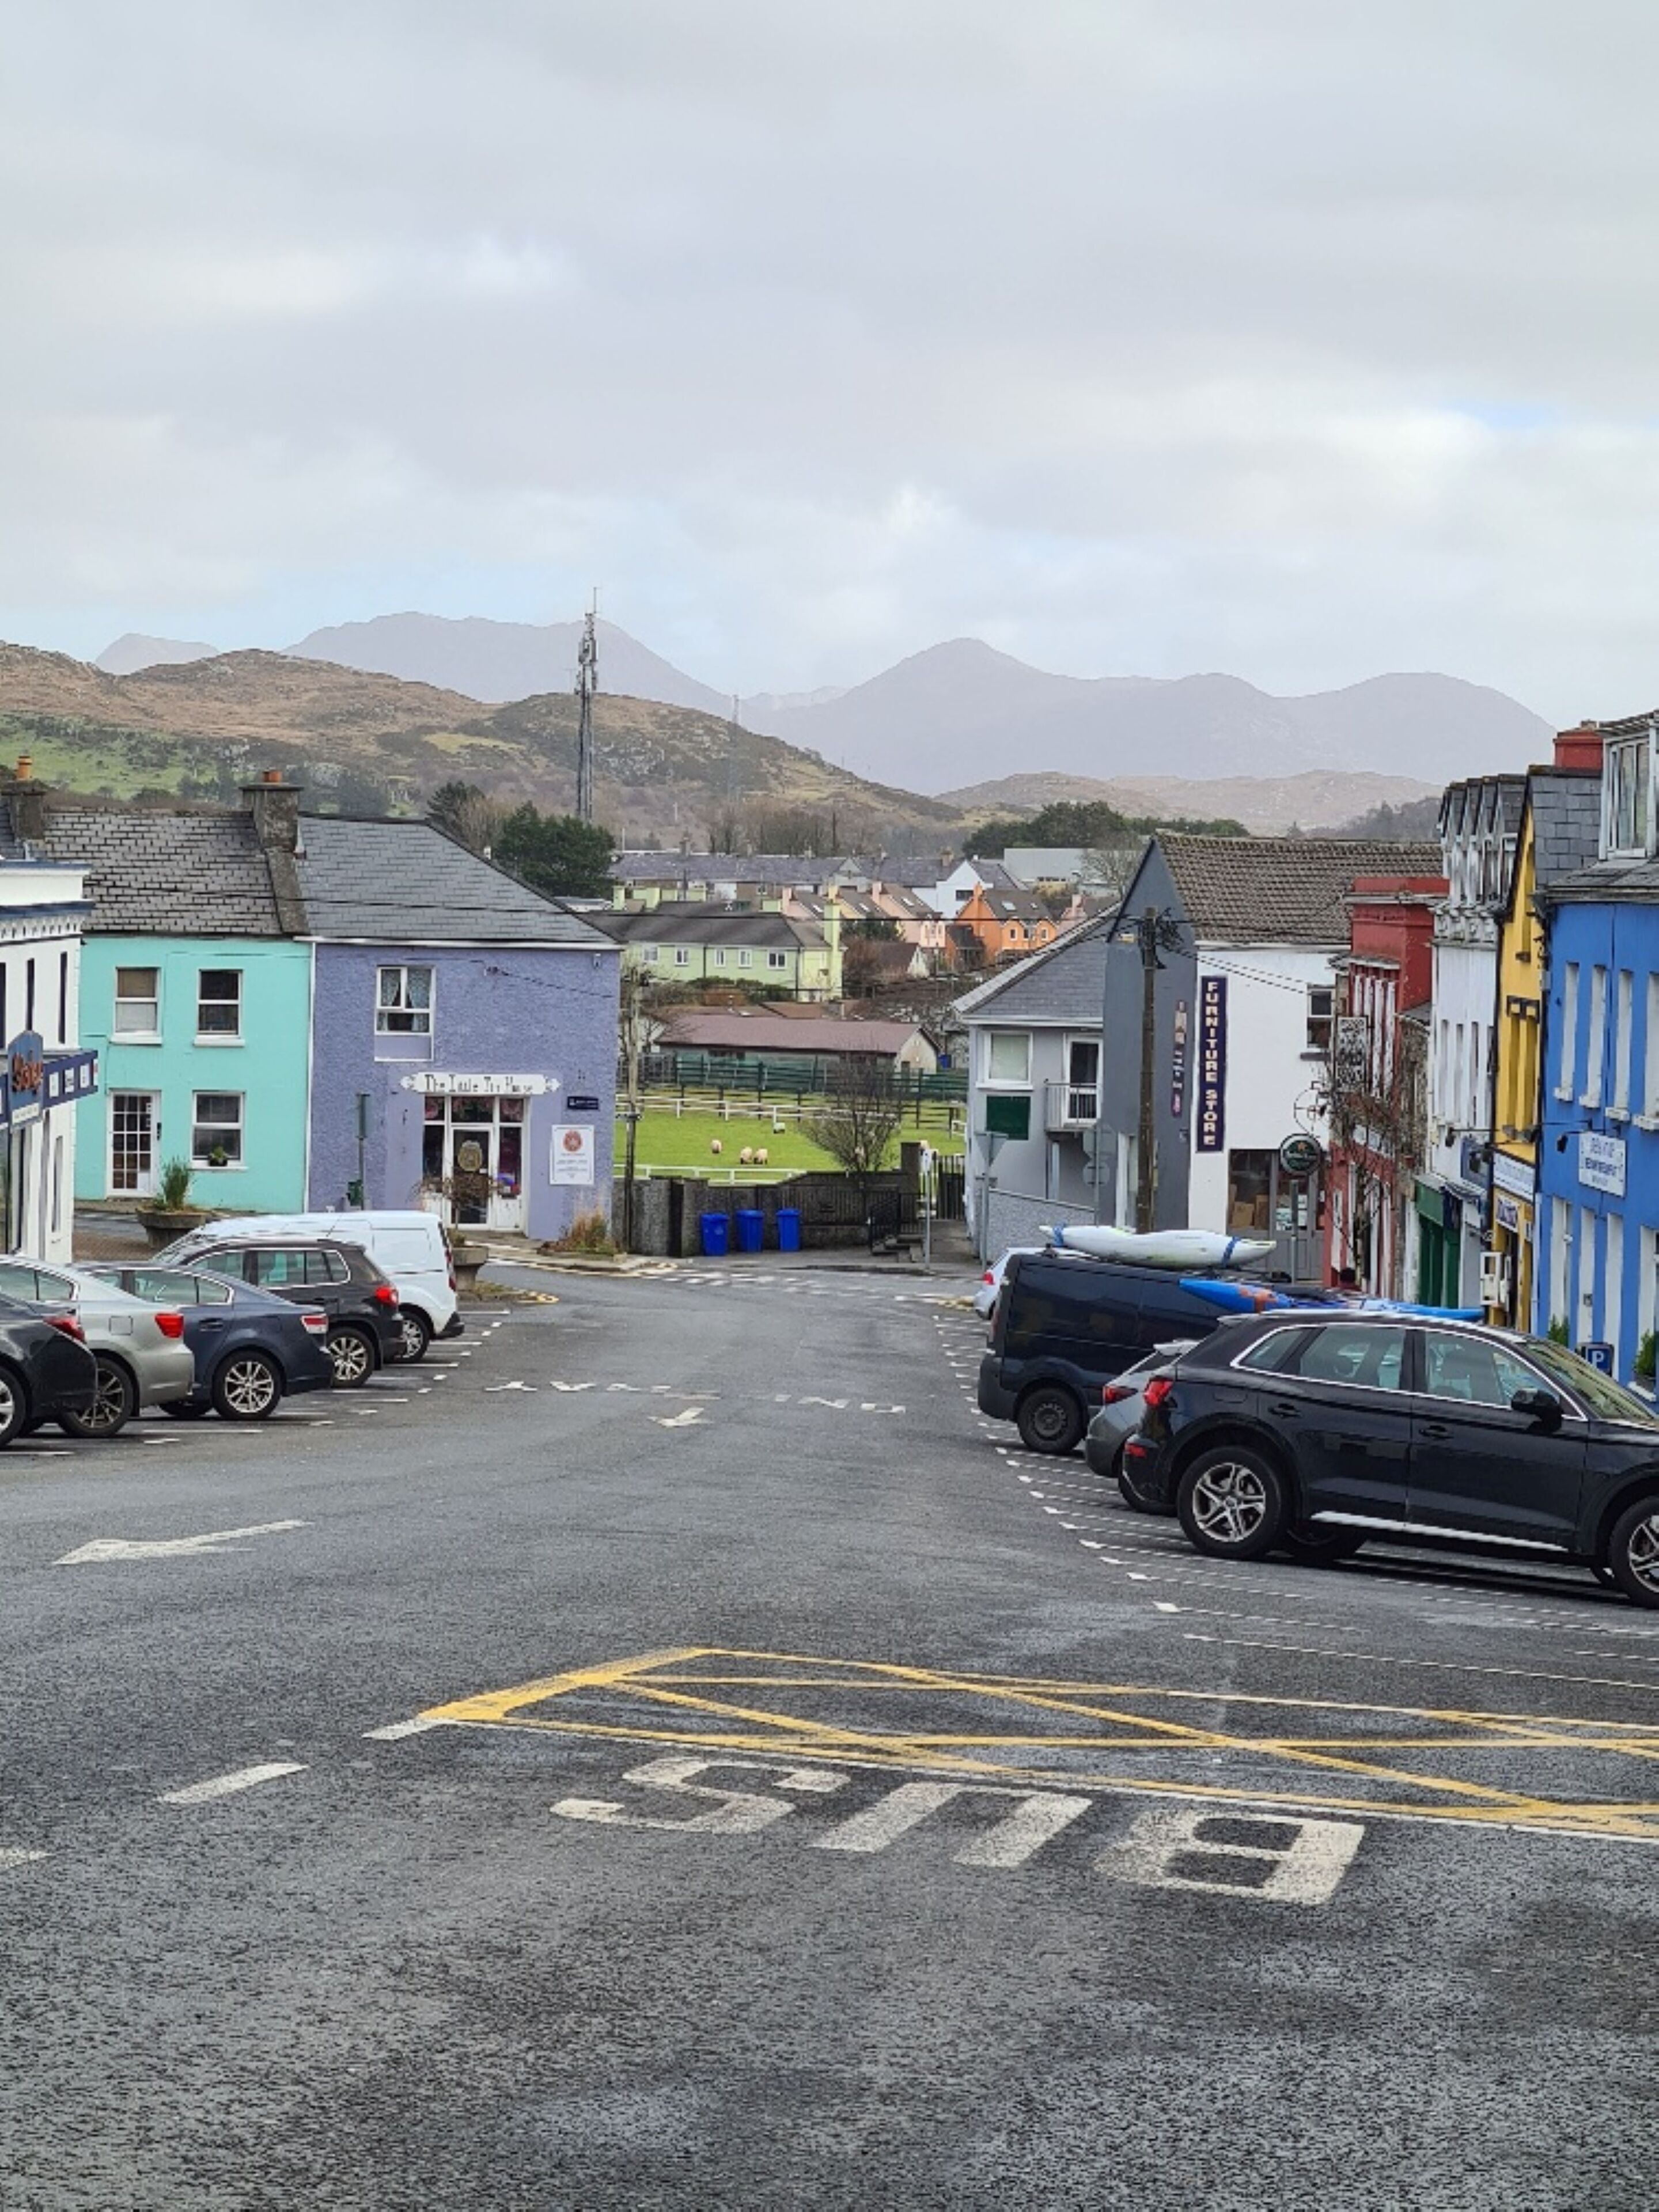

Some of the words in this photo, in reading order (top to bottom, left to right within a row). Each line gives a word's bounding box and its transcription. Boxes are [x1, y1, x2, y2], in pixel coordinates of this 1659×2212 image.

[1205, 982, 1219, 1083] FURNITURE
[424, 1074, 445, 1093] The
[1203, 1089, 1218, 1145] STORE
[1591, 1350, 1604, 1368] P
[547, 1753, 1367, 1906] BUS
